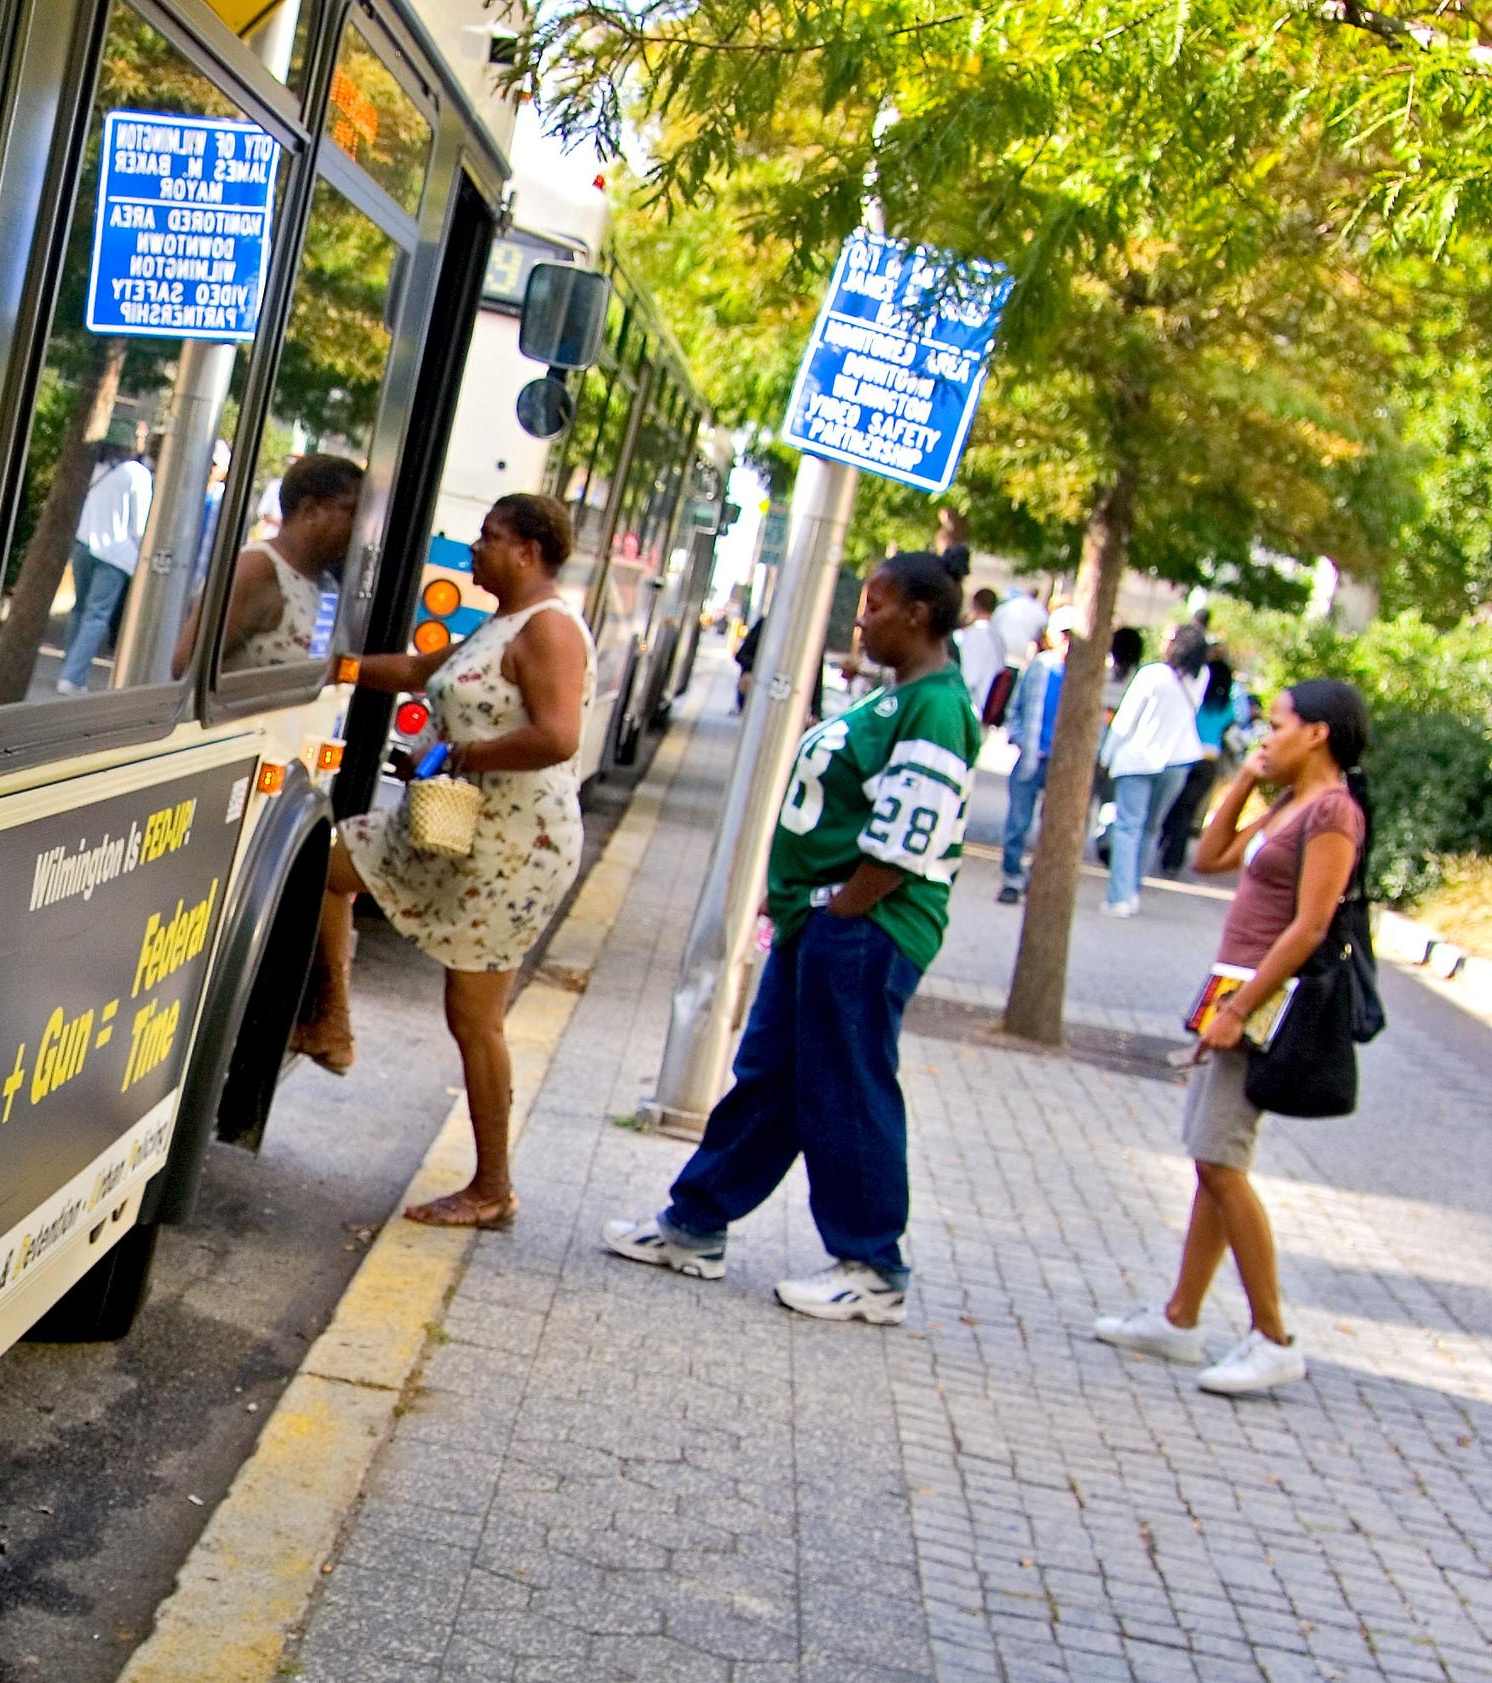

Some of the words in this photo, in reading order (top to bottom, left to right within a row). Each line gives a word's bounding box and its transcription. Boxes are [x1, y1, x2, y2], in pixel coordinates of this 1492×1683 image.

[808, 418, 923, 472] PARTNERSHIP
[868, 412, 942, 453] SAFETY
[29, 833, 125, 912] Wilmington
[123, 821, 142, 874] Is
[139, 798, 197, 865] FED-UP!
[864, 796, 939, 856] 28
[131, 878, 219, 999] Federal
[31, 1006, 94, 1105] Gun
[121, 998, 180, 1093] Time
